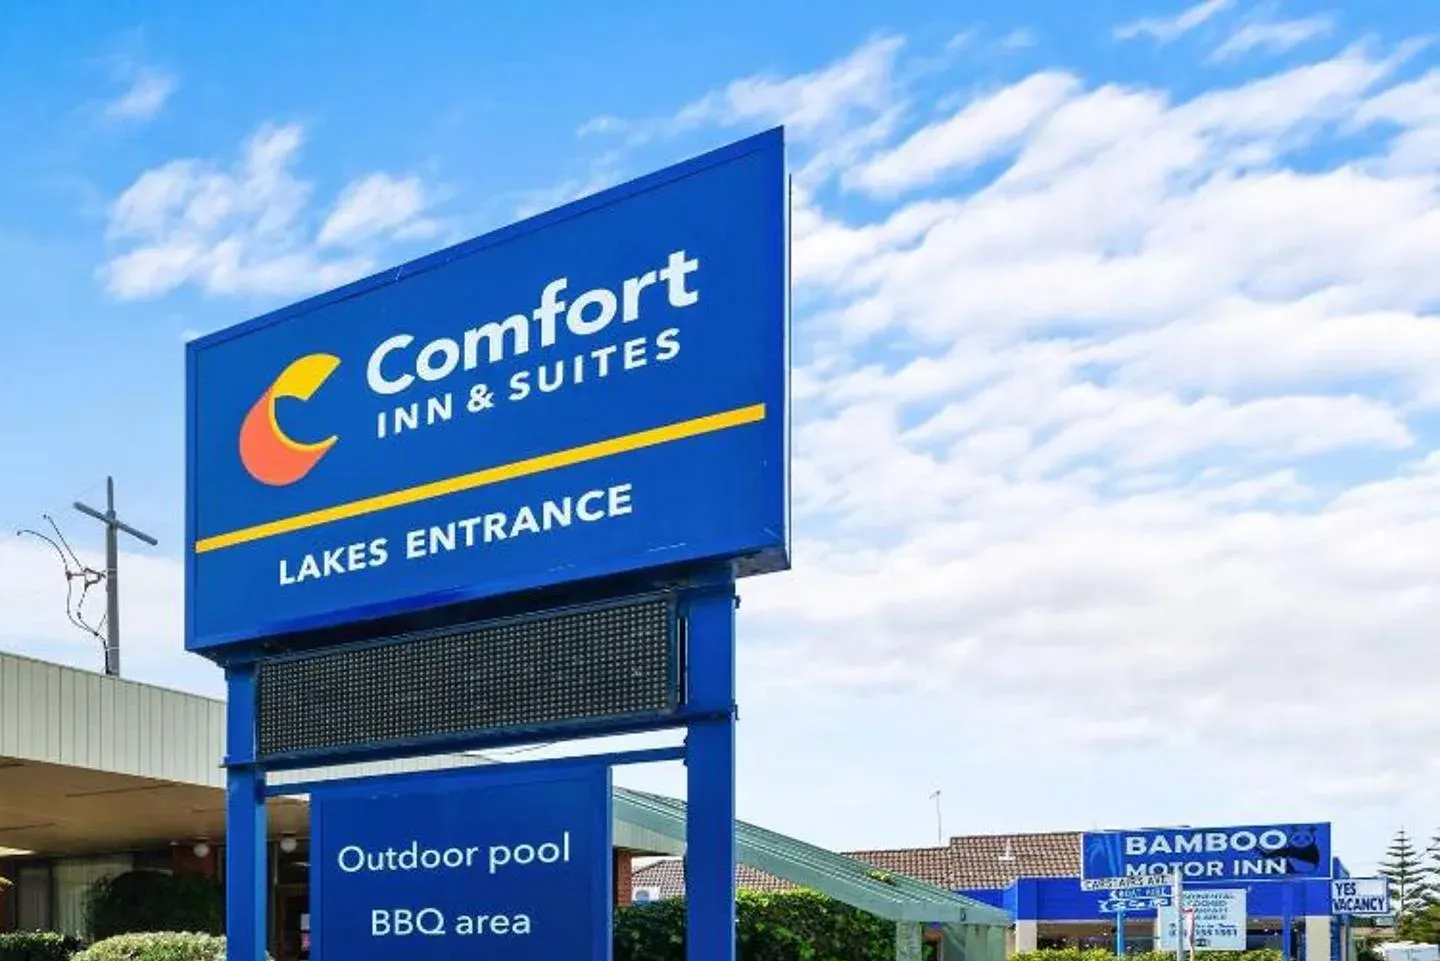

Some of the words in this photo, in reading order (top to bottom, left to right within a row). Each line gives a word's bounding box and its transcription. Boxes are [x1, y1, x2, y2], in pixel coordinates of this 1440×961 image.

[366, 249, 700, 396] Comfort
[376, 392, 453, 439] INN
[466, 381, 495, 415] &
[508, 328, 682, 402] SUITES
[278, 538, 388, 587] LAKES
[406, 483, 633, 560] ENTRANCE
[337, 840, 479, 873] Outdoor
[488, 831, 570, 875] pool
[1125, 829, 1288, 855] BAMBOO
[1126, 859, 1224, 877] MOTOR
[1233, 857, 1288, 876] INN
[1334, 897, 1385, 911] VACANCY
[1335, 882, 1357, 896] YES
[371, 907, 447, 937] BBQ
[456, 911, 531, 935] area
